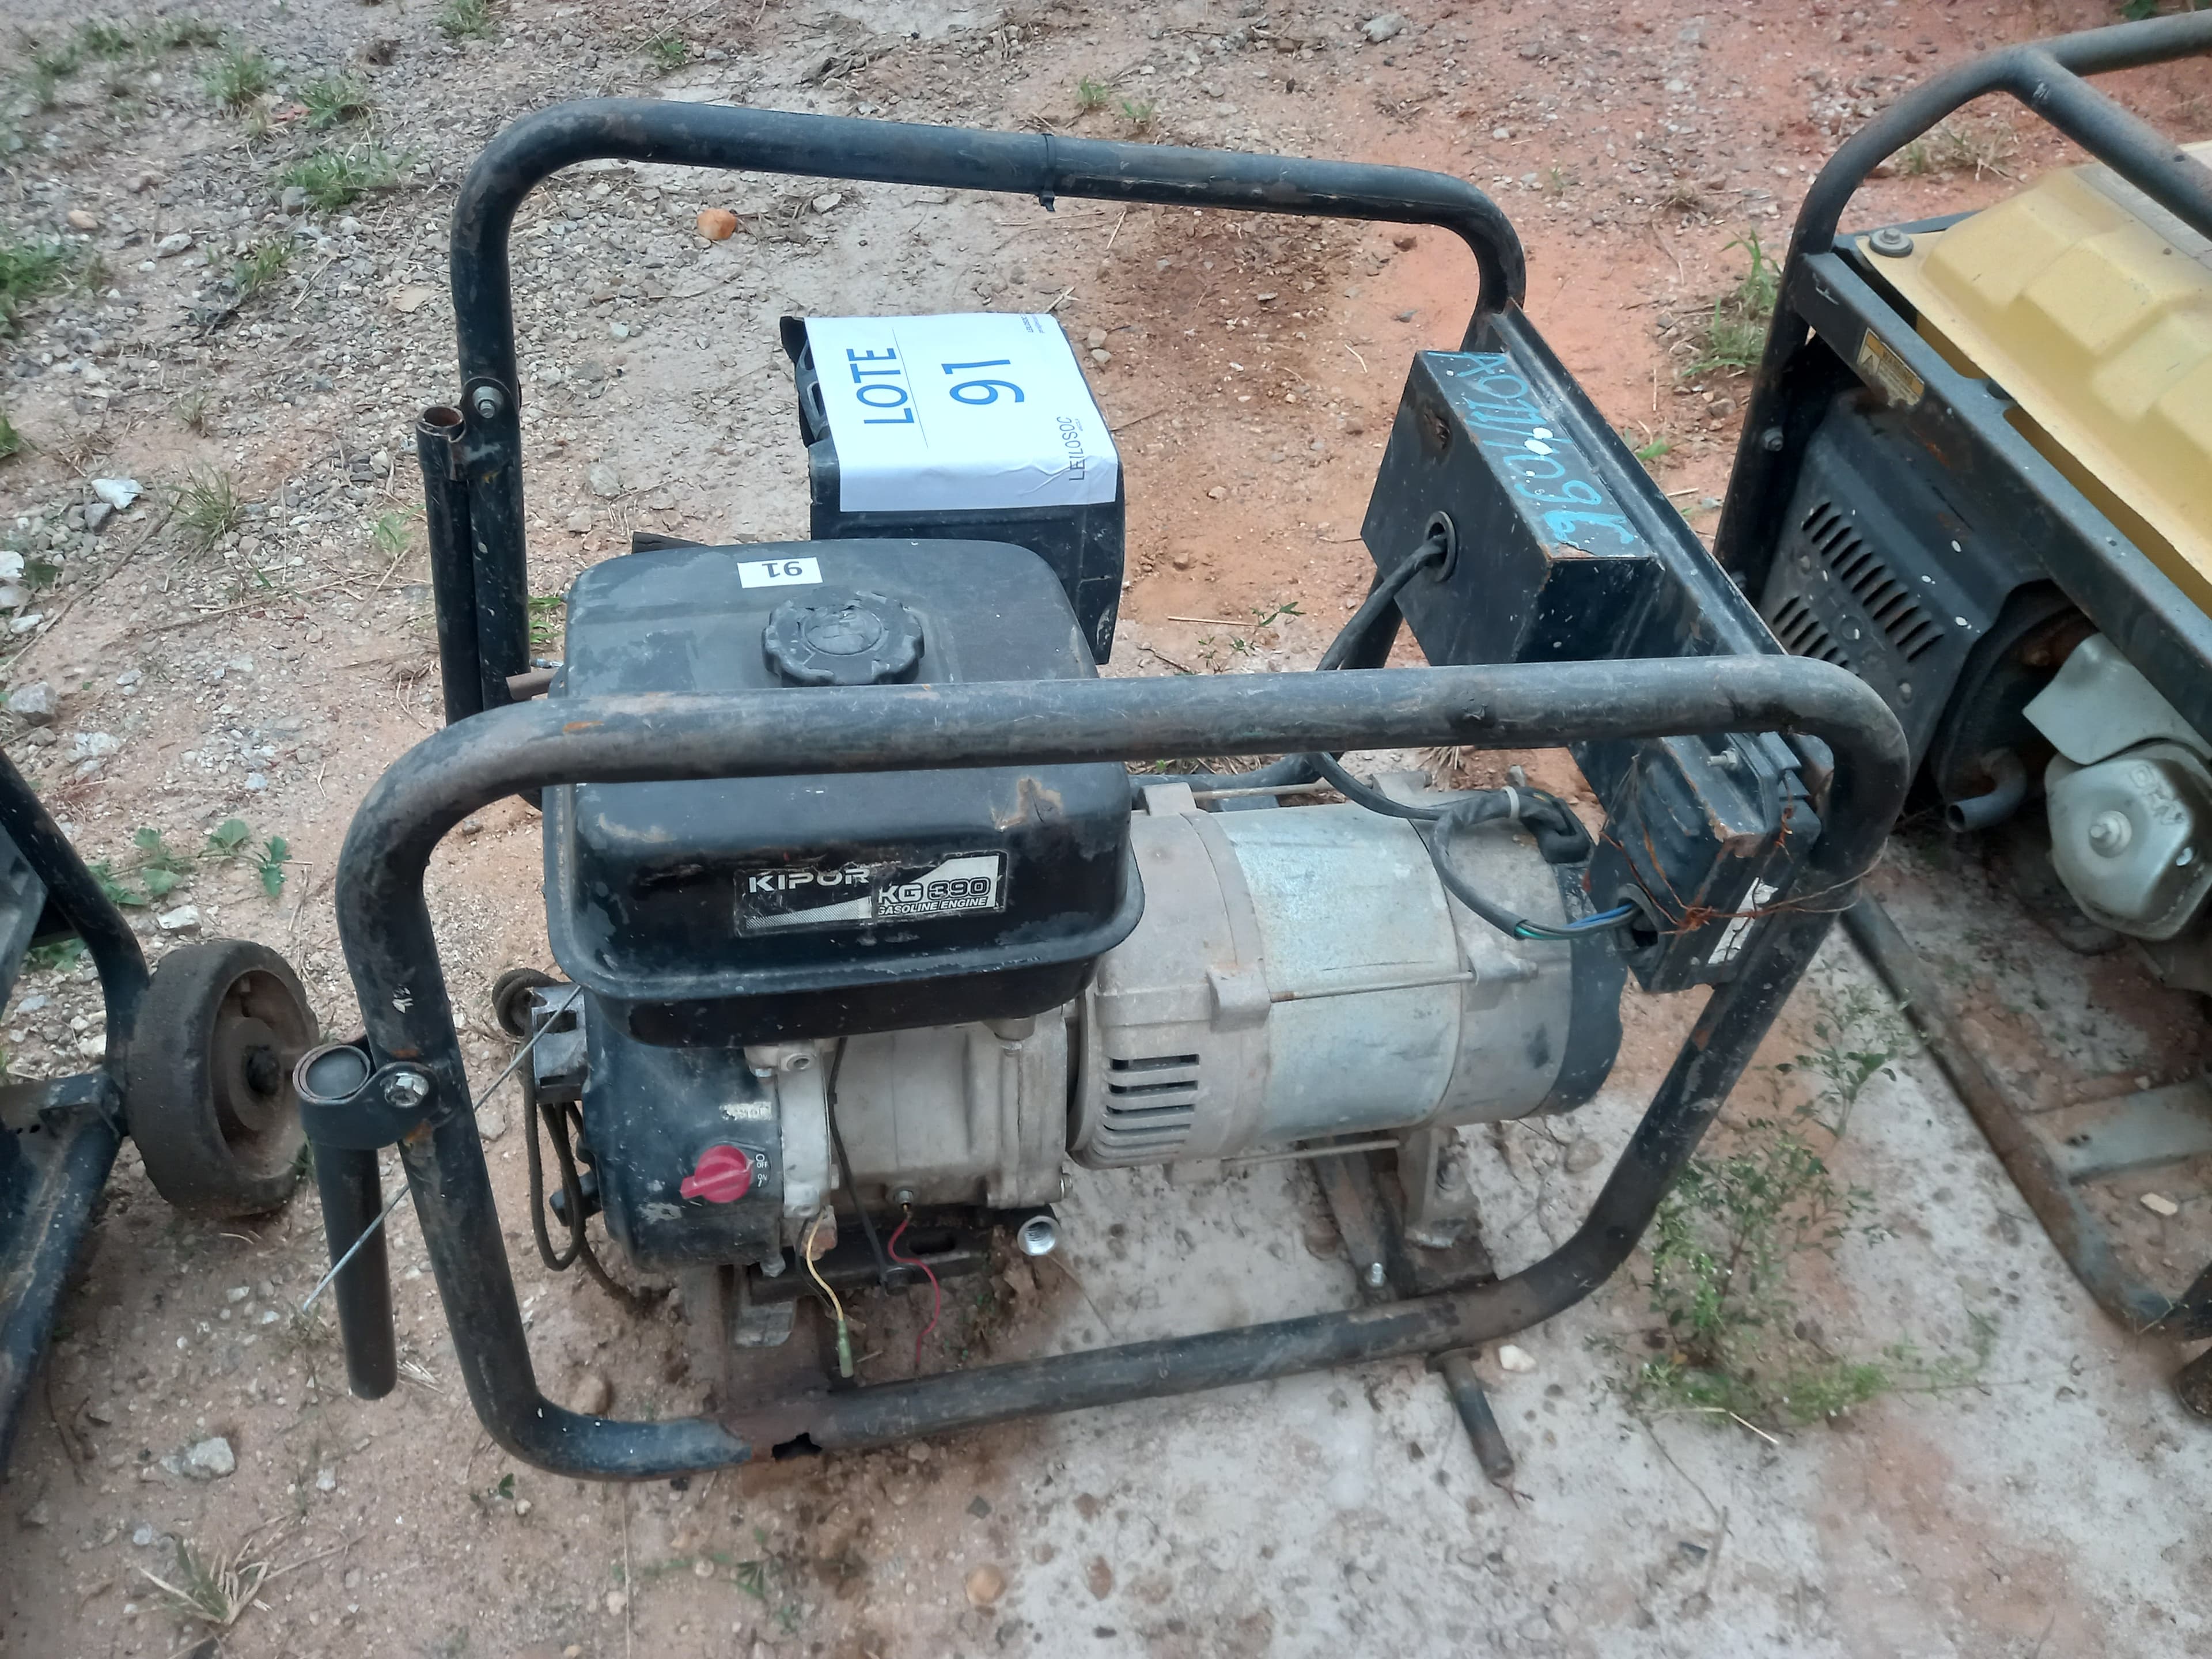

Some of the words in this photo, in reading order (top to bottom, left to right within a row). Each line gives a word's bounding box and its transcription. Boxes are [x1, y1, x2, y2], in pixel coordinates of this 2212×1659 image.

[846, 347, 915, 425] LOTE
[941, 359, 1025, 405] 91
[1056, 415, 1086, 482] LEILOSOC
[762, 560, 803, 578] 91
[749, 868, 870, 893] KIPOR
[878, 883, 923, 905] KG
[927, 876, 991, 901] 390
[878, 900, 939, 916] GASOLINE
[940, 896, 988, 910] ENGINE
